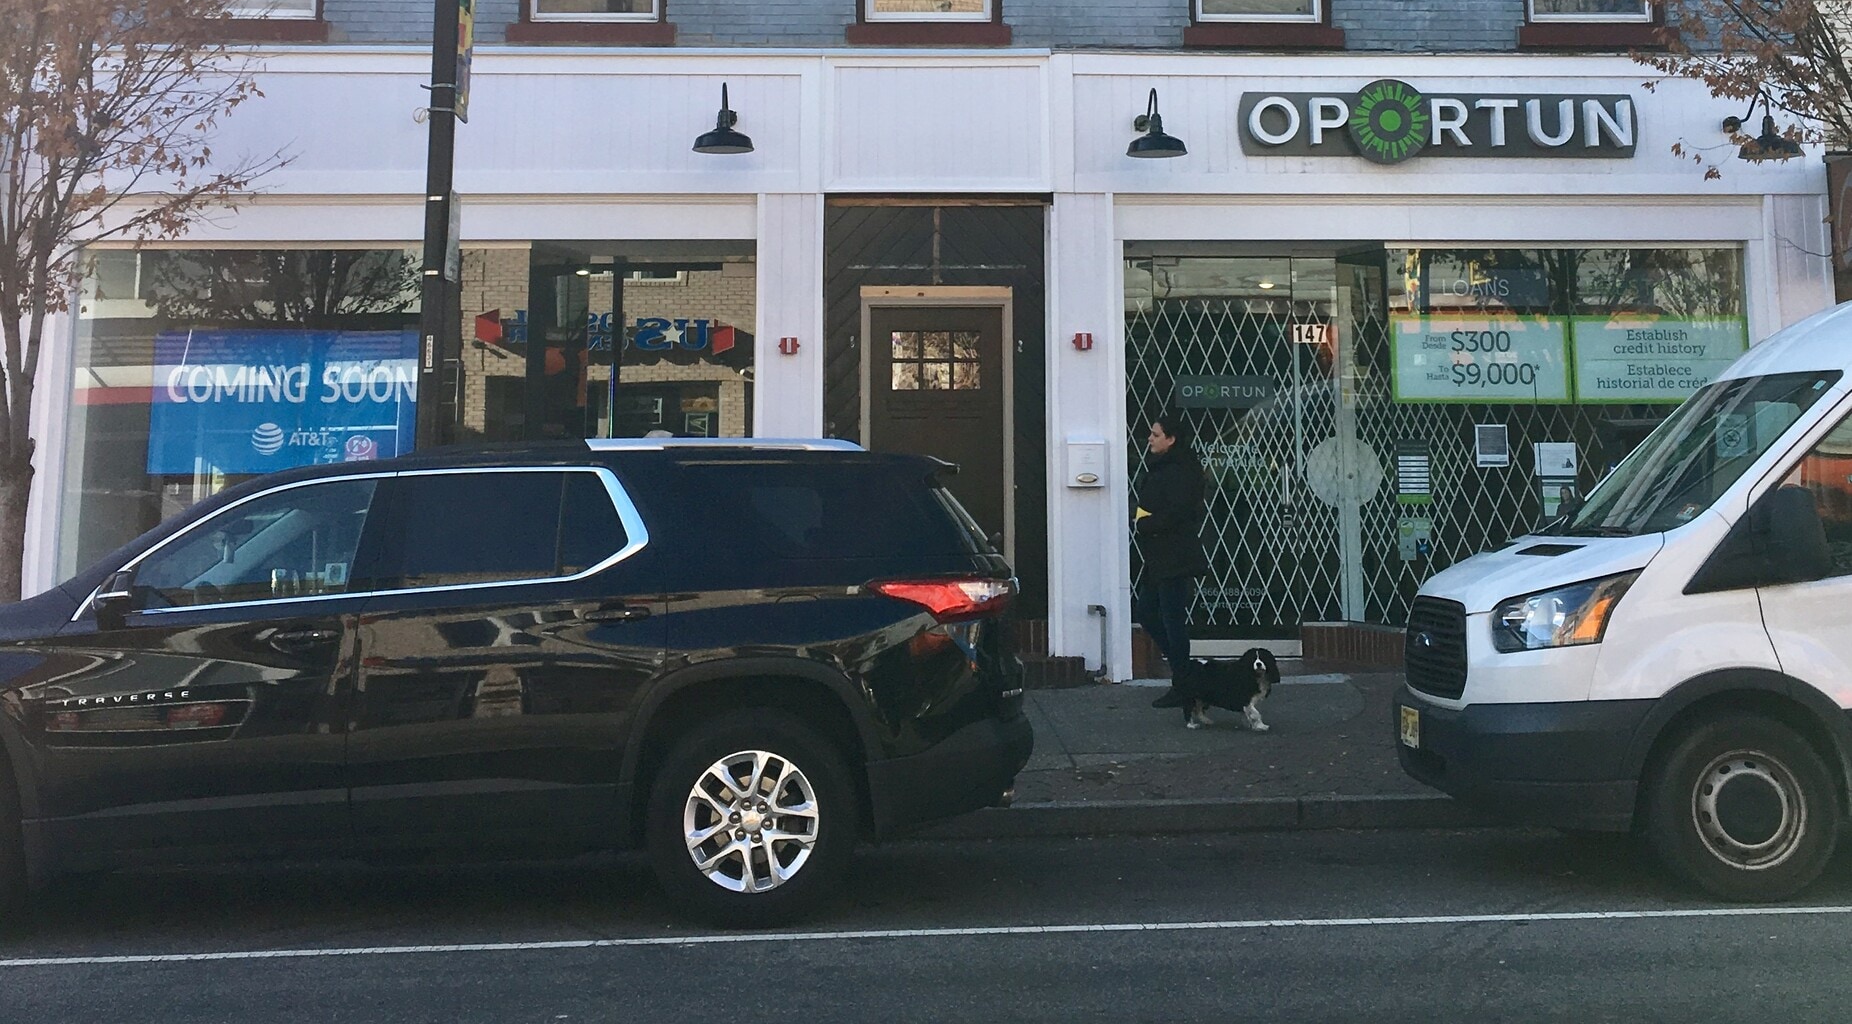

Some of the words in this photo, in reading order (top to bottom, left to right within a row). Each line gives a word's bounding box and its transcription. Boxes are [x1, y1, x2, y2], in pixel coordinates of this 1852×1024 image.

[1249, 83, 1633, 160] OPORTUN
[1442, 278, 1510, 297] LOANS
[1294, 325, 1327, 343] 147
[1626, 329, 1688, 341] Establish
[1422, 341, 1447, 350] Desde
[1424, 334, 1447, 343] From
[1450, 328, 1511, 355] $300
[1613, 342, 1655, 355] credit
[1657, 342, 1706, 356] history
[1438, 365, 1449, 373] To
[1626, 364, 1692, 376] Establece
[1426, 372, 1449, 381] Hasta
[1597, 377, 1655, 389] historial
[1657, 377, 1676, 389] de
[1678, 377, 1712, 389] créd
[166, 365, 308, 404] COMING
[320, 364, 418, 404] SOON
[1181, 384, 1266, 399] OPORTUN
[288, 432, 329, 447] AT&T
[1192, 441, 1259, 454] Welcome
[62, 690, 190, 707] TRAVERSE
